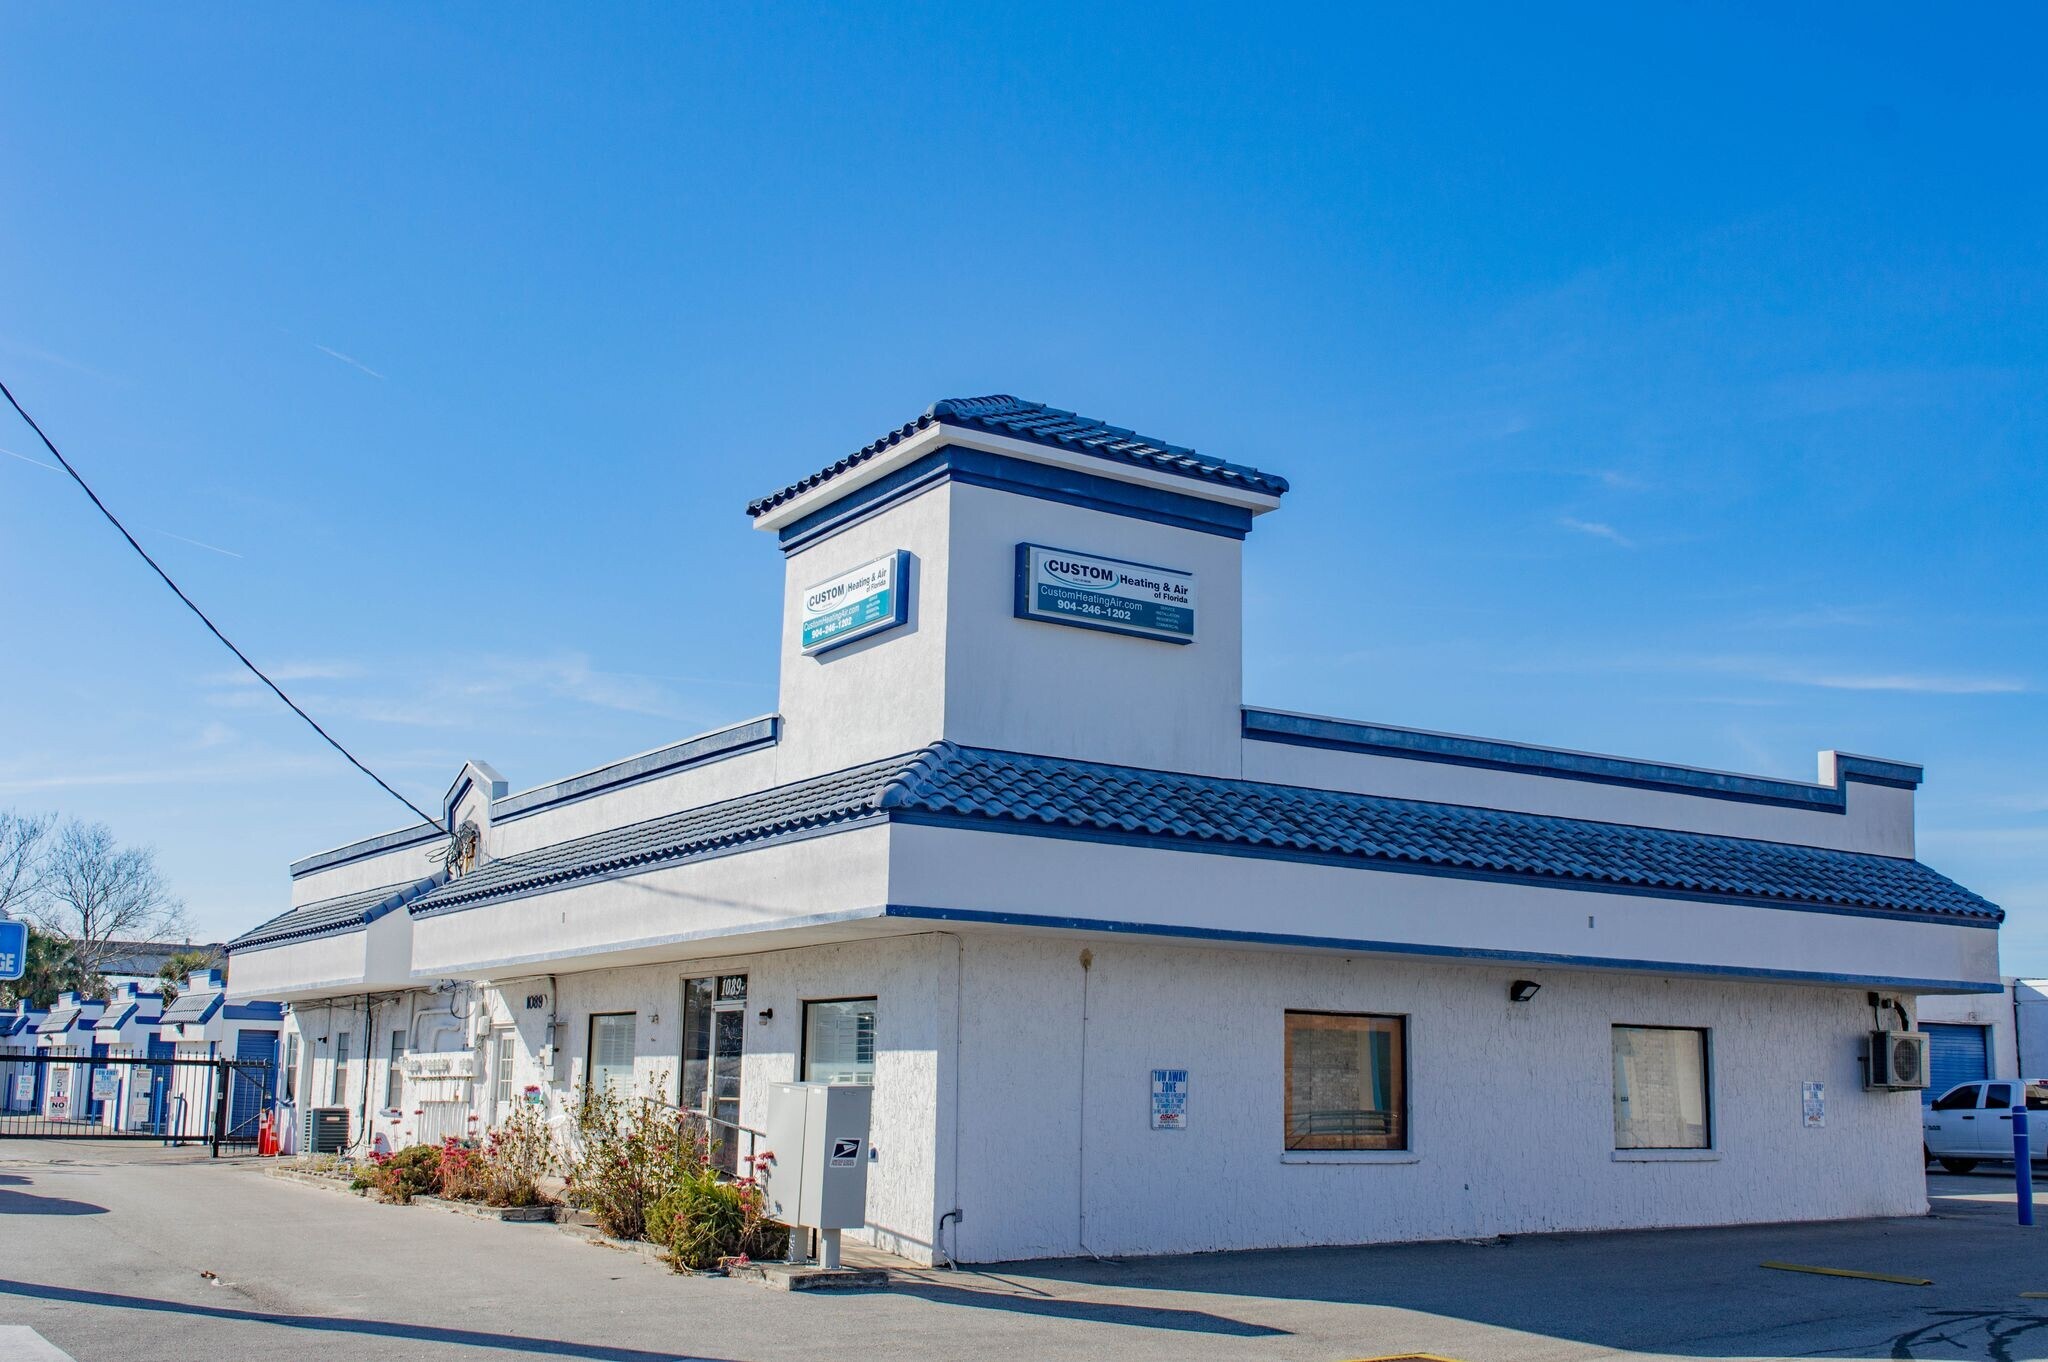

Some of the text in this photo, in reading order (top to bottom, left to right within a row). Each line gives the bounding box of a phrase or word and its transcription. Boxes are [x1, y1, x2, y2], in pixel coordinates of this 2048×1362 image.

[866, 579, 887, 593] of Florida
[1048, 559, 1113, 582] CUSTOM
[1120, 574, 1160, 592] Heating
[1163, 582, 1171, 592] &
[1173, 584, 1189, 596] Air
[809, 583, 845, 607] CUSTOM
[847, 576, 871, 592] Heating
[871, 572, 876, 582] &
[877, 568, 887, 578] Air
[1040, 585, 1143, 611] CustomHeatingAir.com
[1163, 593, 1188, 604] Florida
[803, 604, 860, 632] CustomHeatingAir.com
[1057, 599, 1131, 620] 904-246-1202
[811, 617, 853, 639] 904-246-1202
[720, 977, 742, 996] 1089
[526, 995, 543, 1009] 1089
[56, 1079, 63, 1087] 5
[1154, 1071, 1187, 1082] TOW AWAY
[1162, 1082, 1176, 1092] ZONE
